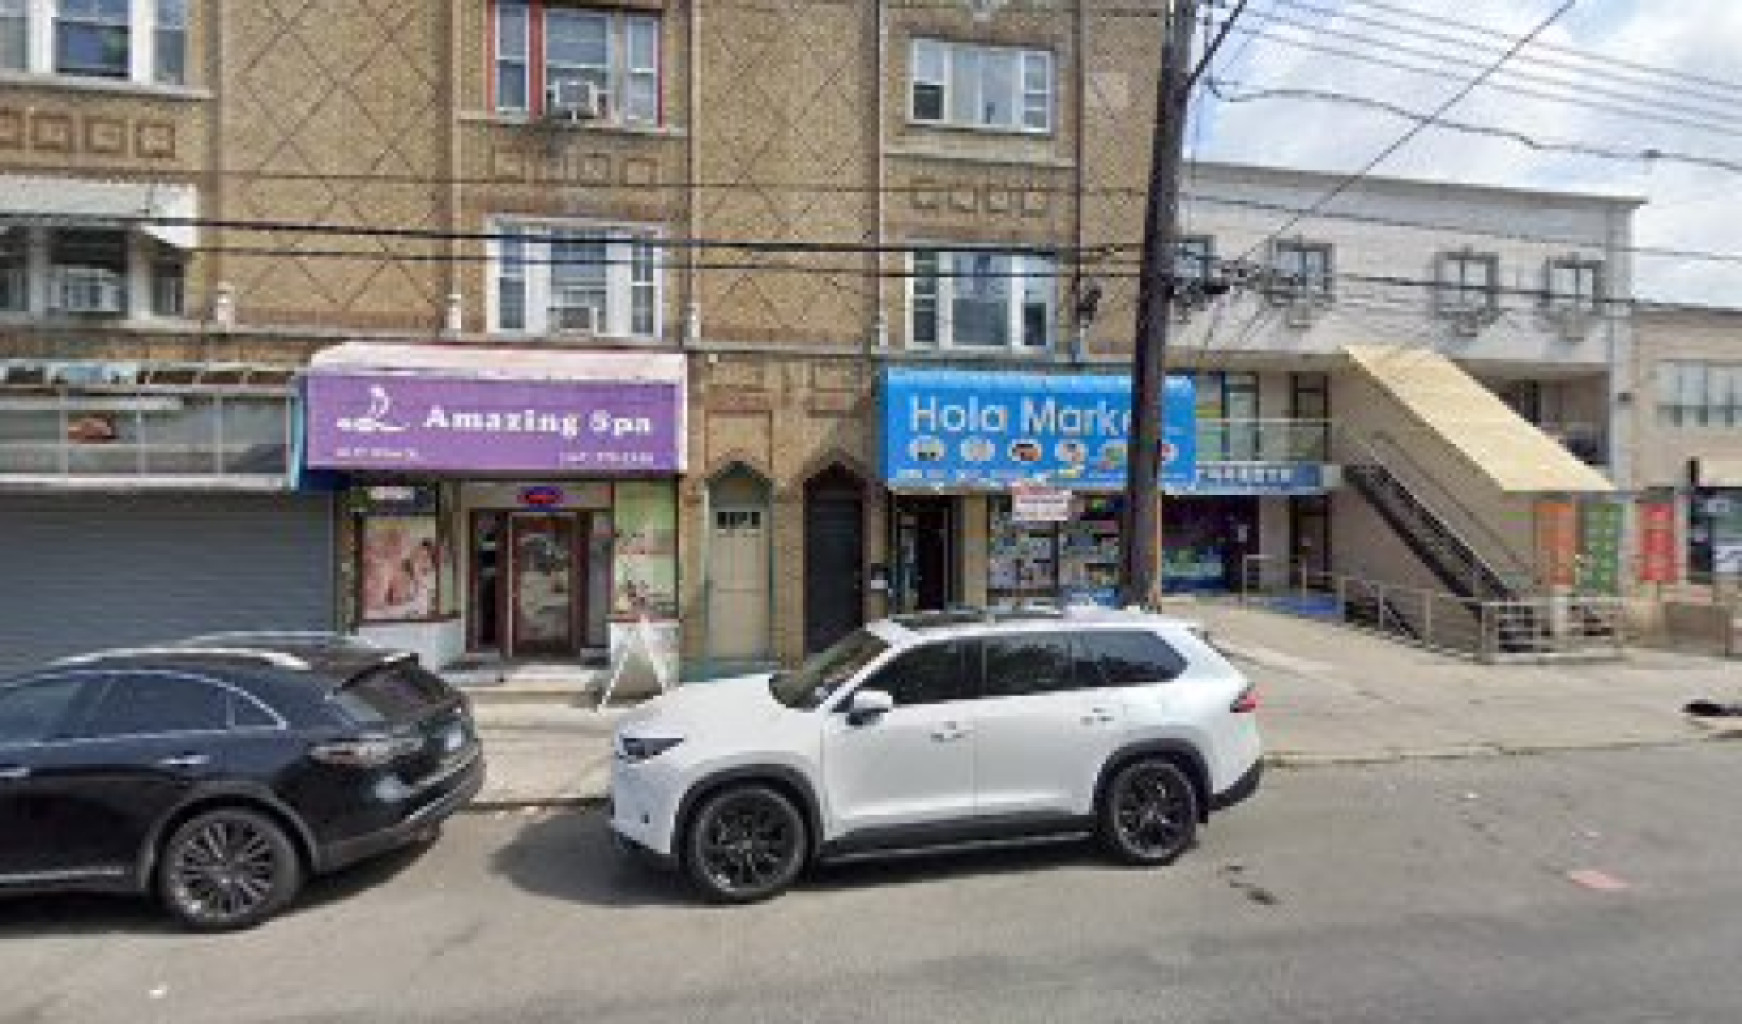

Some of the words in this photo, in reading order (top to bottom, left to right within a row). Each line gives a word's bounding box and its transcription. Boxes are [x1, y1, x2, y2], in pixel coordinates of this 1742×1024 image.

[423, 405, 580, 438] Amazing
[590, 409, 651, 437] Spa
[910, 396, 1008, 432] Hola
